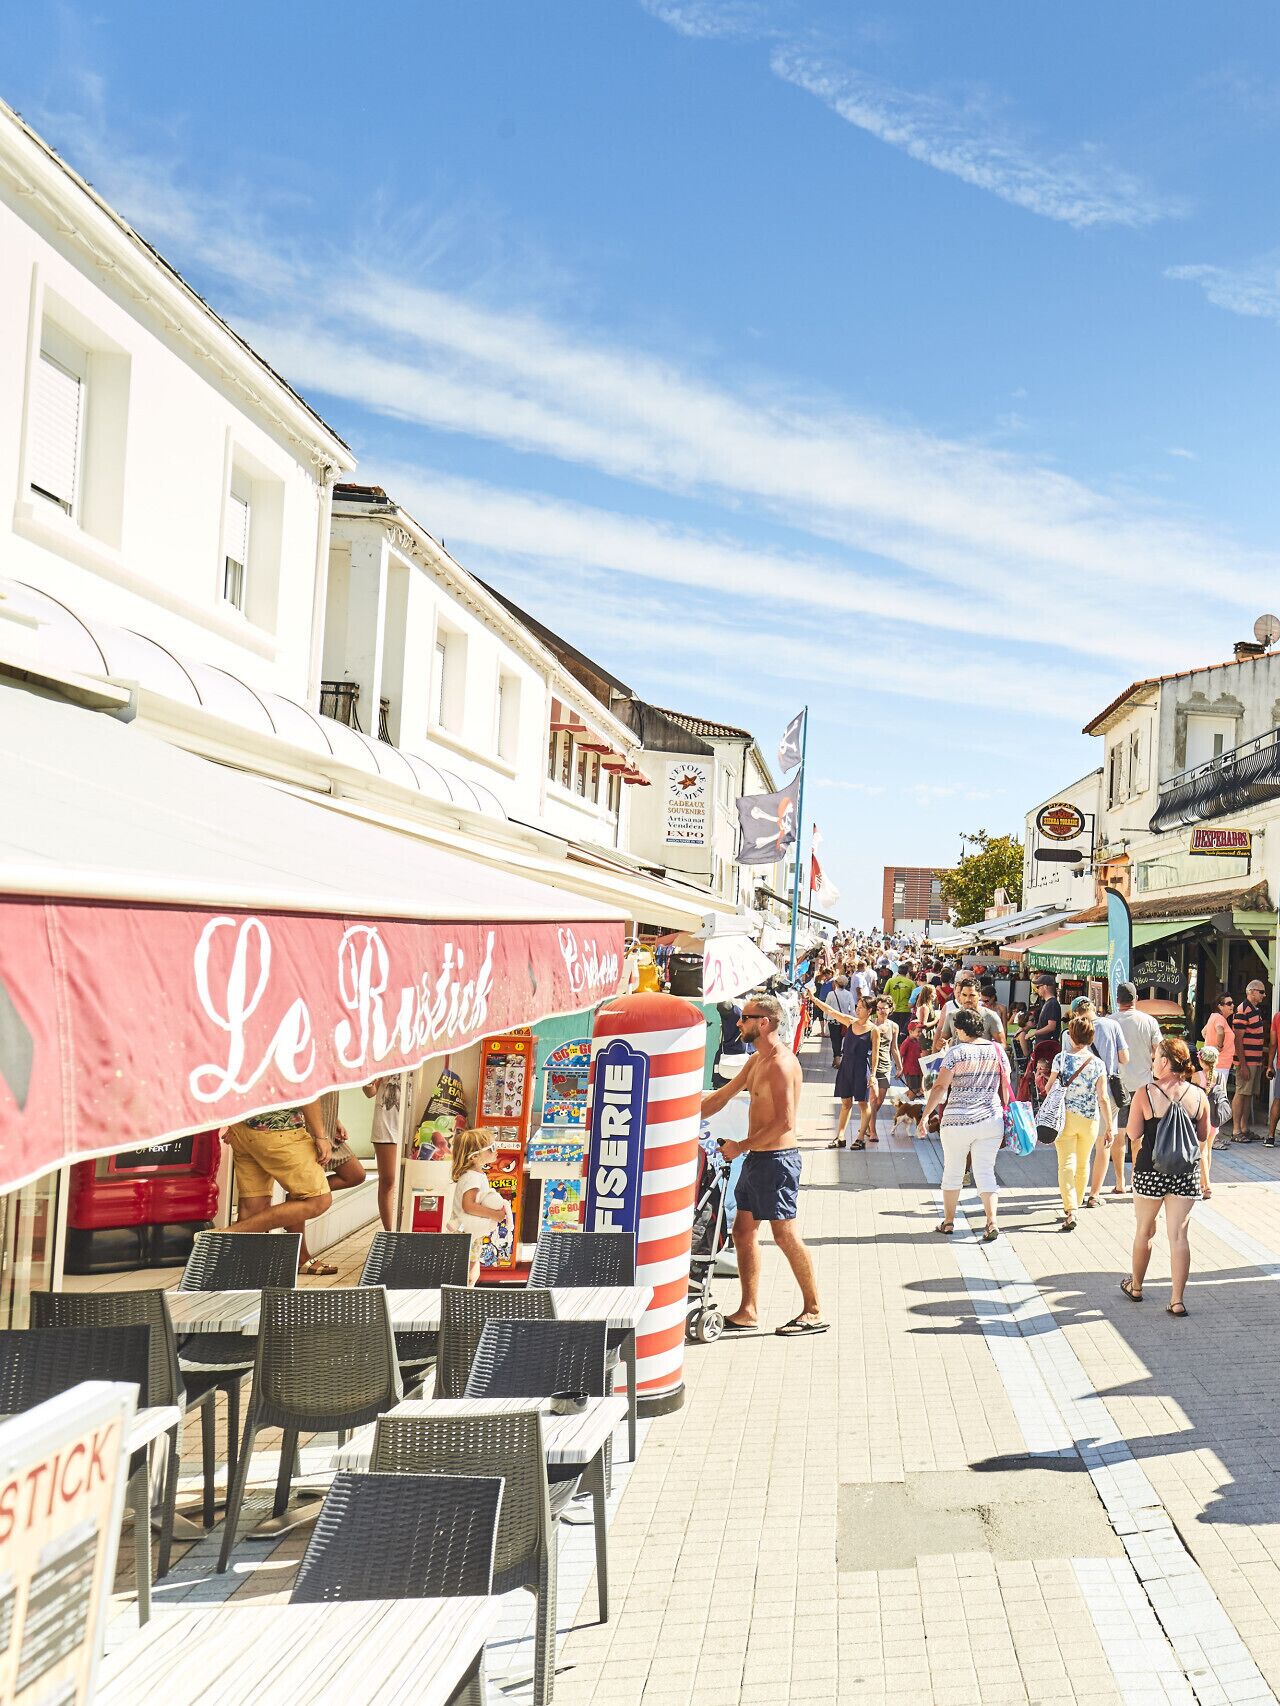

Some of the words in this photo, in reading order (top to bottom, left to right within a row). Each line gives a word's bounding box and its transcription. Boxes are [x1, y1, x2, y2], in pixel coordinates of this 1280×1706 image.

[670, 784, 683, 798] DE
[684, 786, 705, 800] MER
[667, 807, 705, 816] SOUVENIRS
[668, 799, 705, 808] CADEAUX
[667, 830, 704, 838] EXPO
[1193, 829, 1248, 848] DESPERADOS
[189, 916, 317, 1104] Le
[334, 924, 495, 1068] Rustick
[594, 1064, 634, 1233] FISERIE
